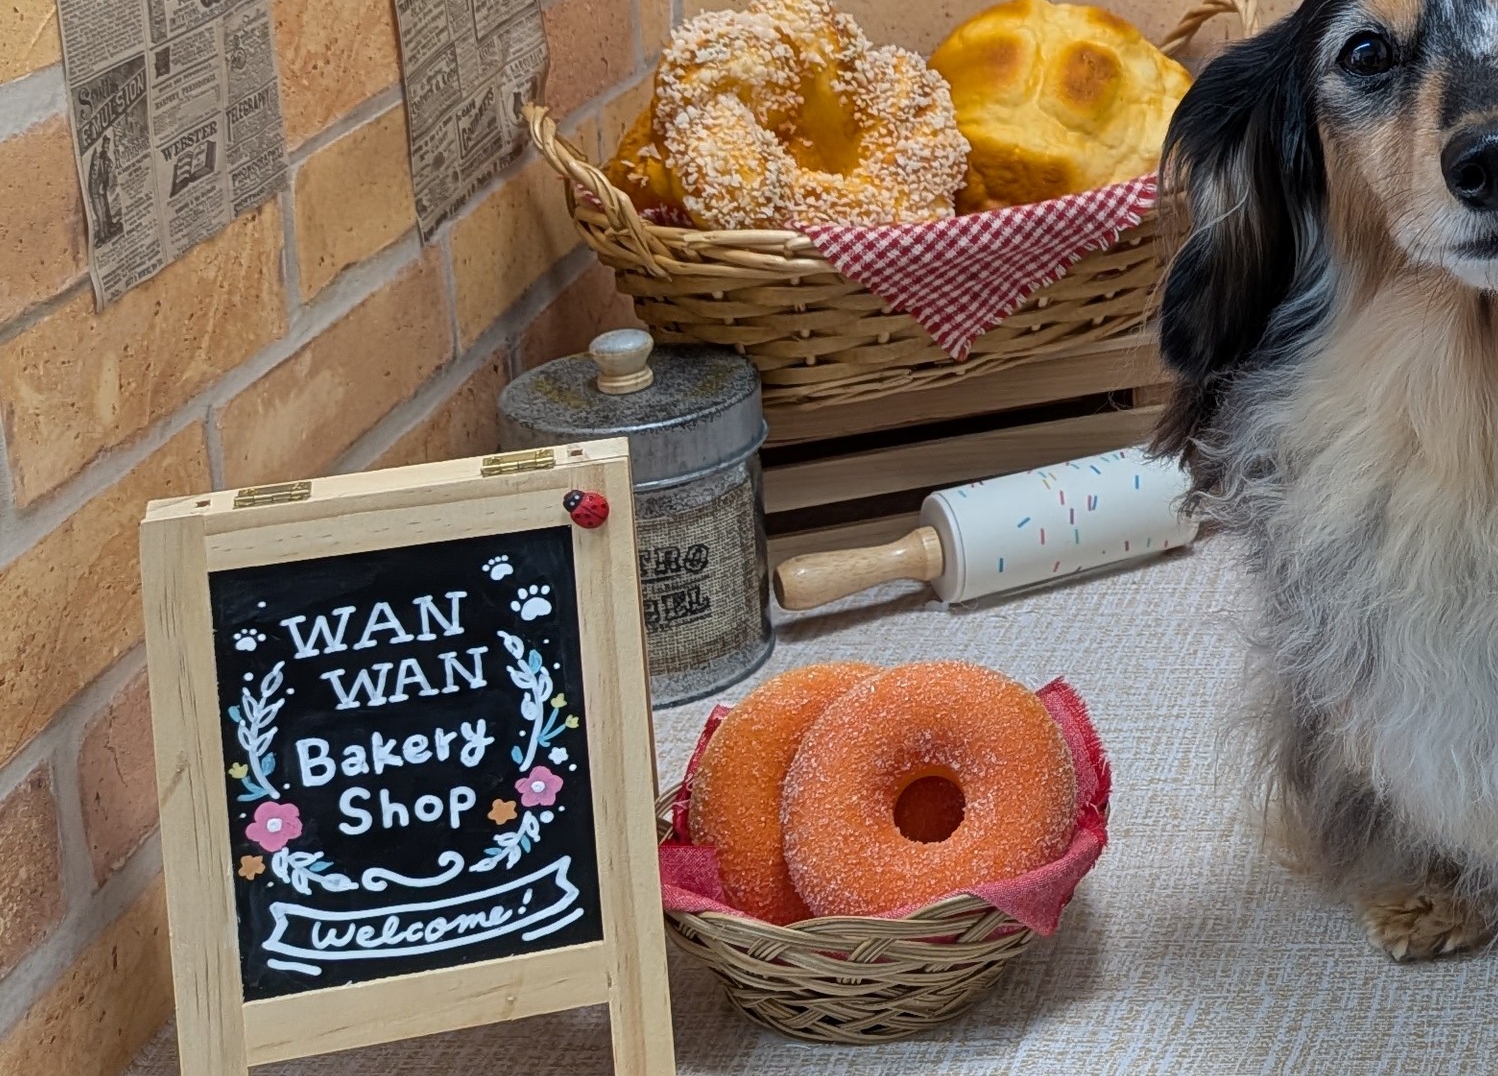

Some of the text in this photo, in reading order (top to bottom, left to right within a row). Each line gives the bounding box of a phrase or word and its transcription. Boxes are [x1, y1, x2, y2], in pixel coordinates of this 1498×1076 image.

[82, 71, 145, 146] EMULSION
[161, 120, 217, 162] WEBSTER
[280, 590, 468, 659] WAN
[320, 646, 489, 711] WAN
[296, 718, 495, 788] Bakery
[339, 785, 476, 836] Shop
[310, 887, 532, 950] Welcome!
